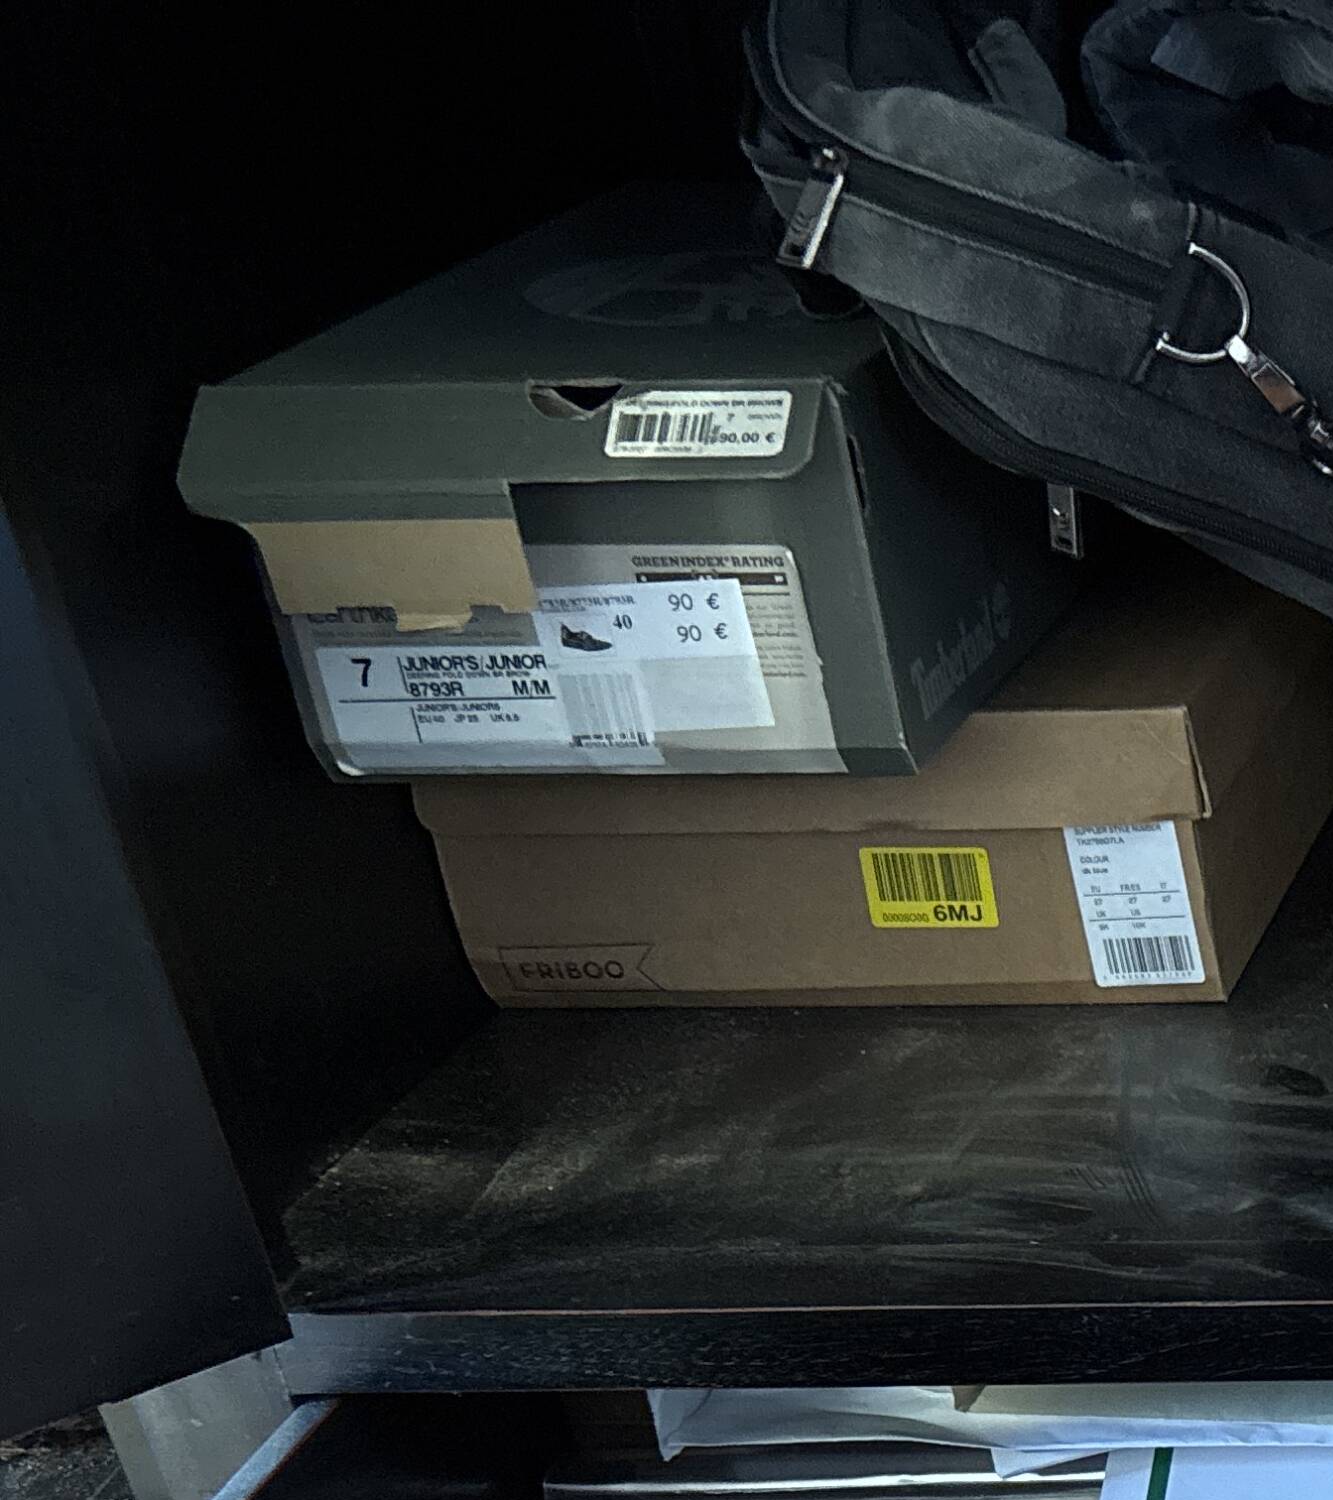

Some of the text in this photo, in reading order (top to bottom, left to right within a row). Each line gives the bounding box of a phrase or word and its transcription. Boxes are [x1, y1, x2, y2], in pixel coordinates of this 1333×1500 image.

[764, 432, 776, 443] €
[732, 555, 785, 567] RATING
[668, 592, 720, 611] 90 €
[613, 614, 633, 630] 40
[676, 622, 728, 643] 90 €
[351, 658, 372, 687] 7
[409, 681, 465, 697] 8793R
[933, 904, 983, 922] 6MJ
[519, 959, 625, 980] FRIBOO
